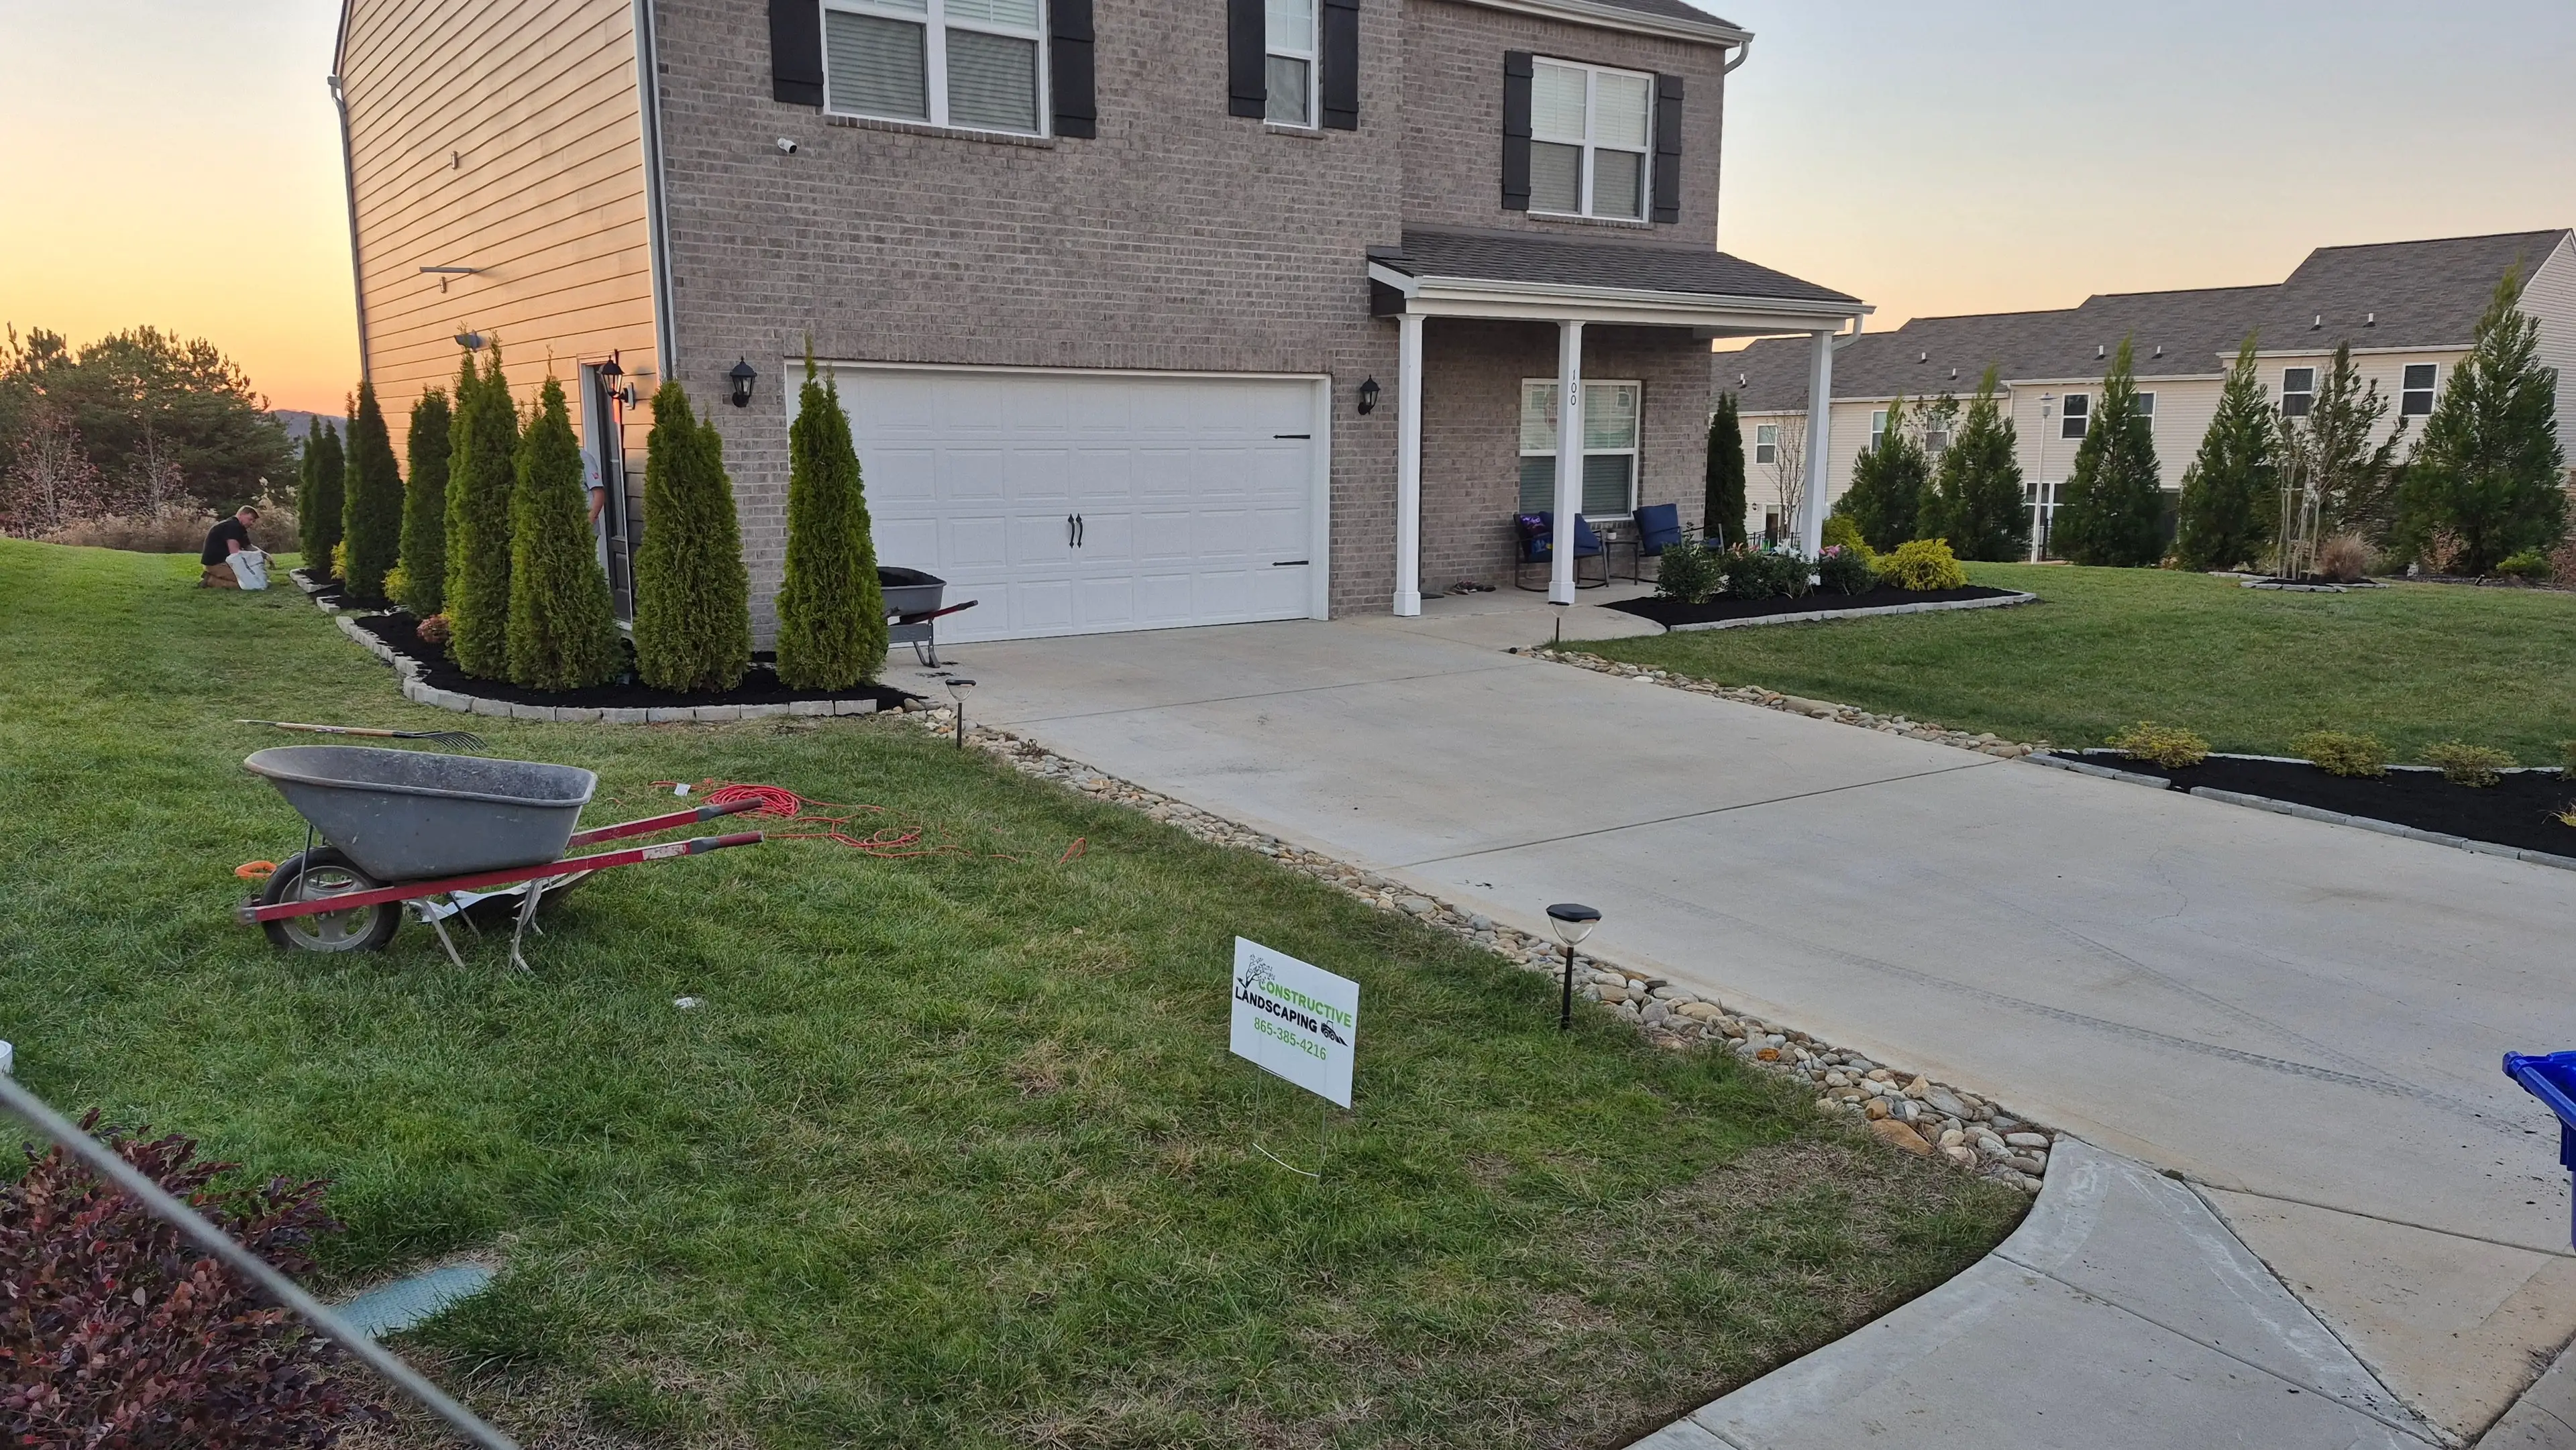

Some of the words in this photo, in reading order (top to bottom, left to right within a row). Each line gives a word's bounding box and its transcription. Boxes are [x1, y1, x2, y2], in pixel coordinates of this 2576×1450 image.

[1235, 987, 1318, 1033] LANDSCAPING
[1258, 981, 1352, 1027] CONSTRUCTIVE
[1254, 1017, 1327, 1060] 865-385-4216
